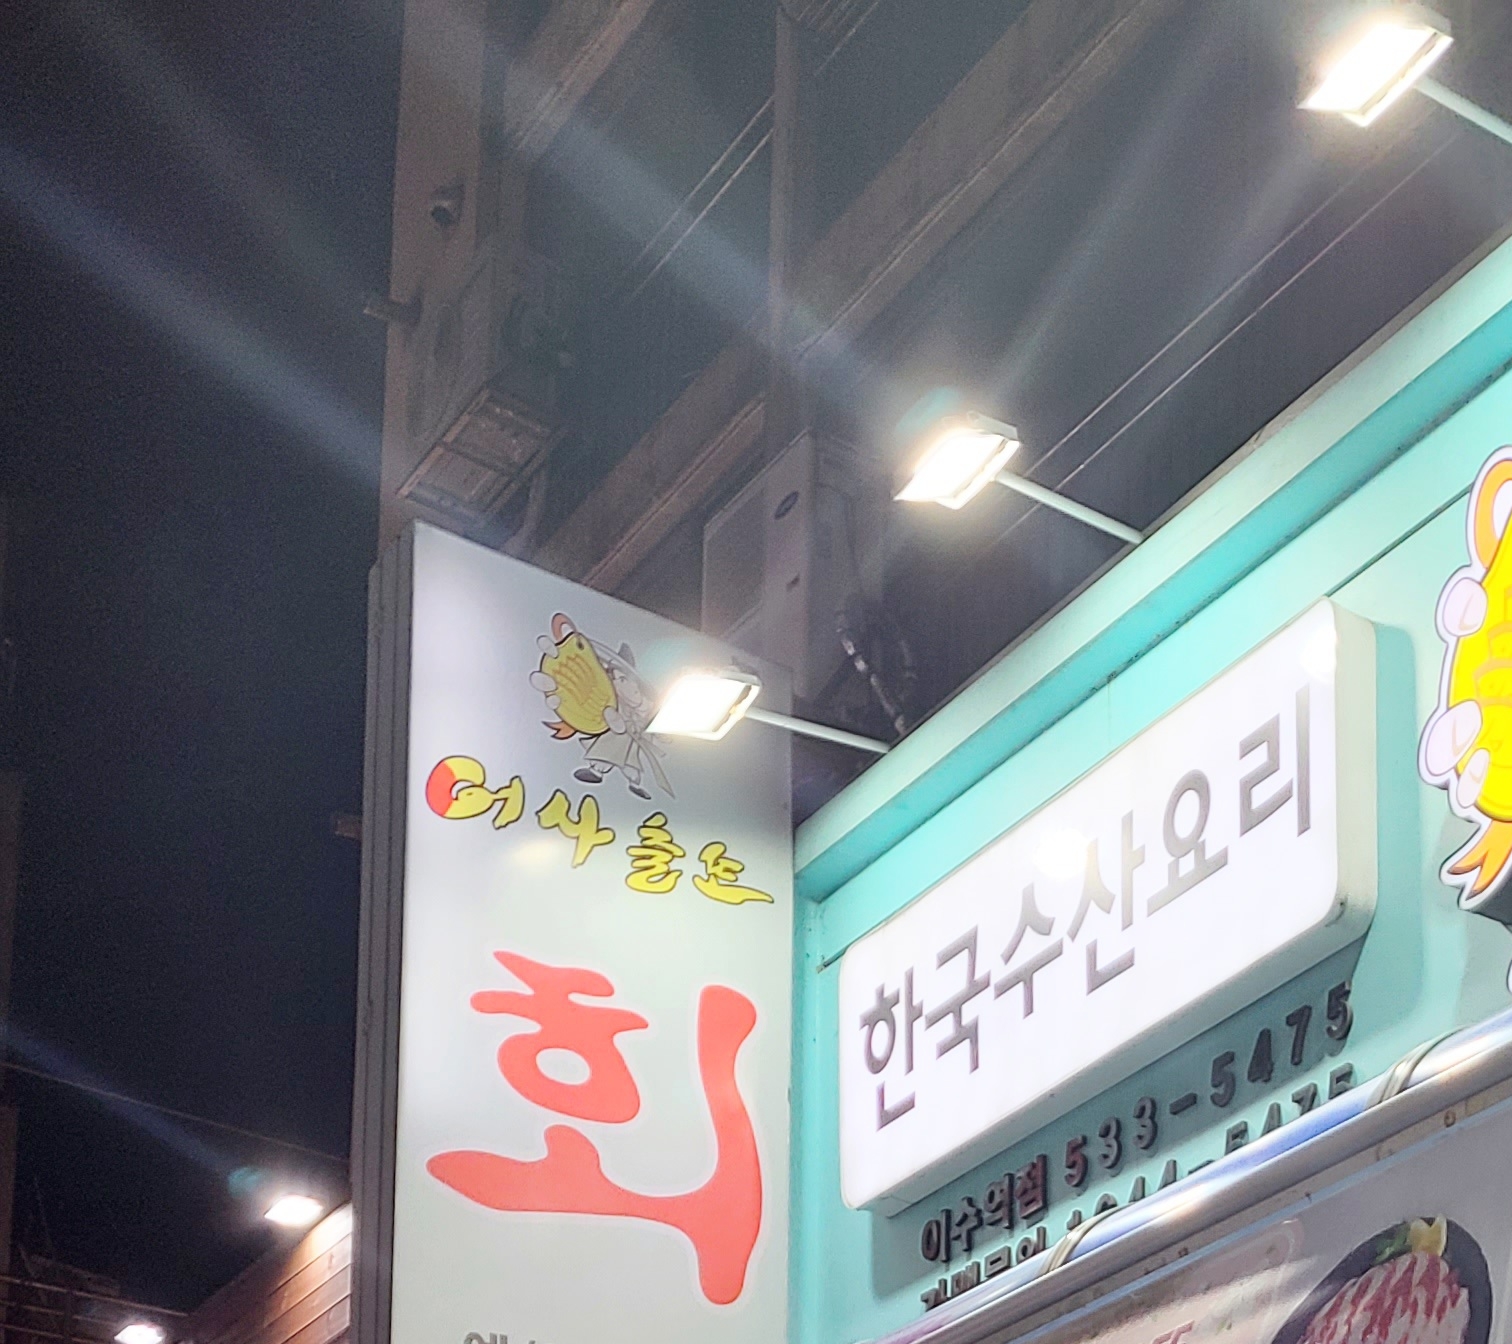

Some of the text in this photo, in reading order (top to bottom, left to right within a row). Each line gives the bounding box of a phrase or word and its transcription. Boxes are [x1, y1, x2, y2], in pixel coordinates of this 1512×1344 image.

[426, 755, 775, 904] 어사출또
[859, 683, 1312, 1132] 한국수산요리
[426, 950, 763, 1306] 회
[1063, 981, 1354, 1187] 533-5475
